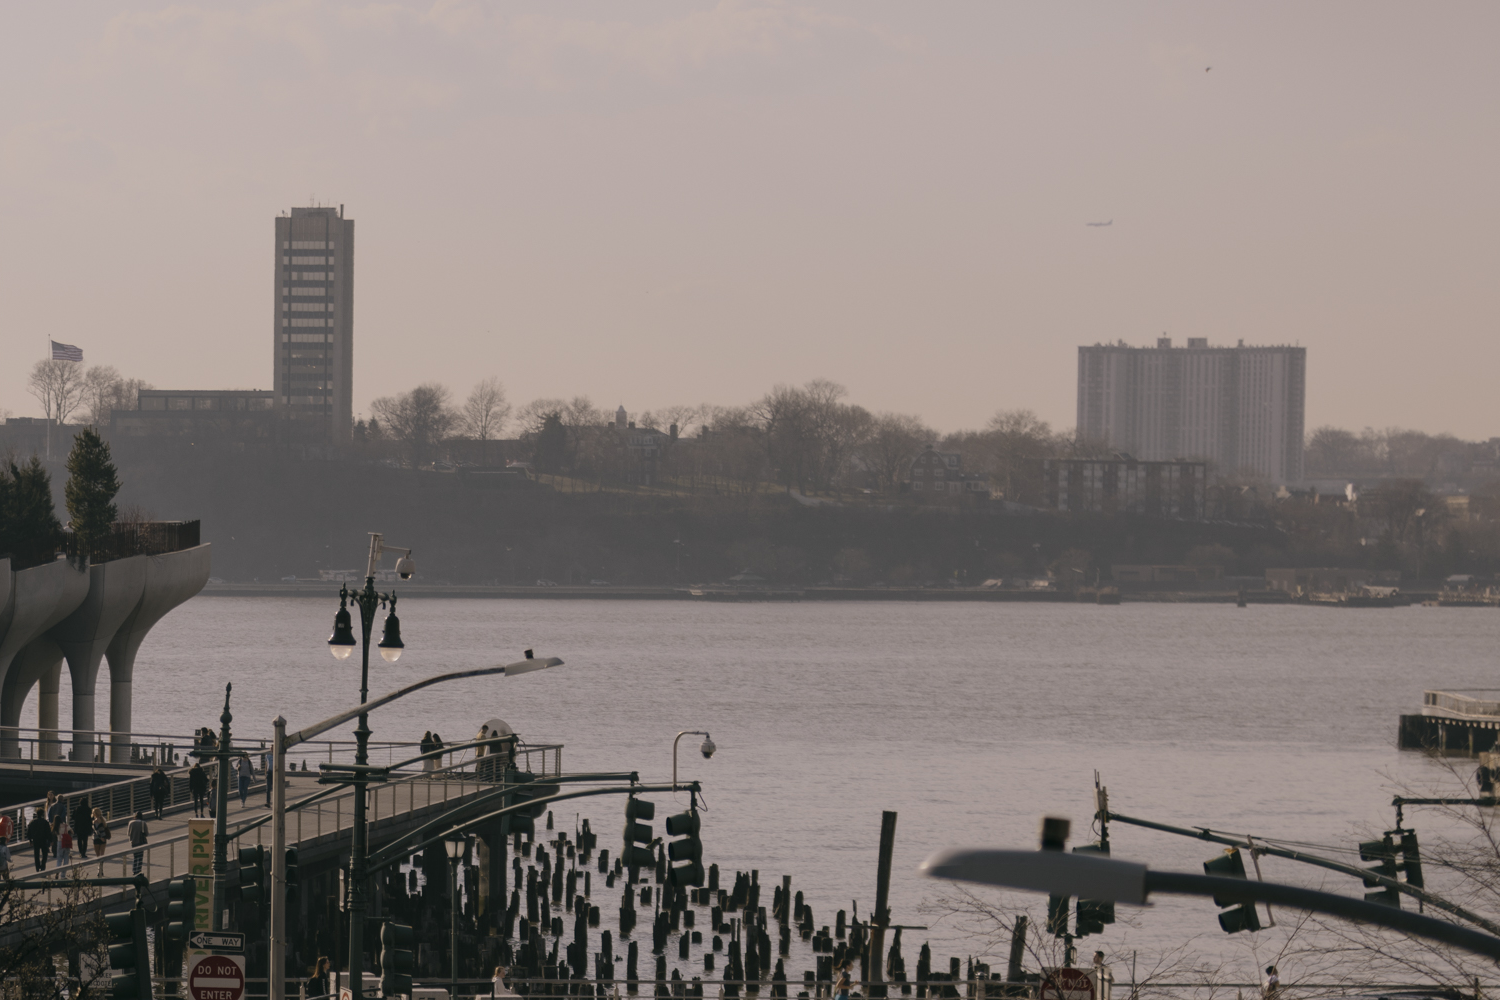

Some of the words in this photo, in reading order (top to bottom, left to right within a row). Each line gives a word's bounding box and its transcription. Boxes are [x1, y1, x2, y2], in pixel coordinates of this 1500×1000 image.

[192, 828, 210, 859] PK
[196, 936, 213, 946] ONE
[221, 937, 241, 947] WAY
[197, 965, 212, 976] DO
[217, 965, 237, 976] NOT
[200, 990, 233, 1000] ENTER
